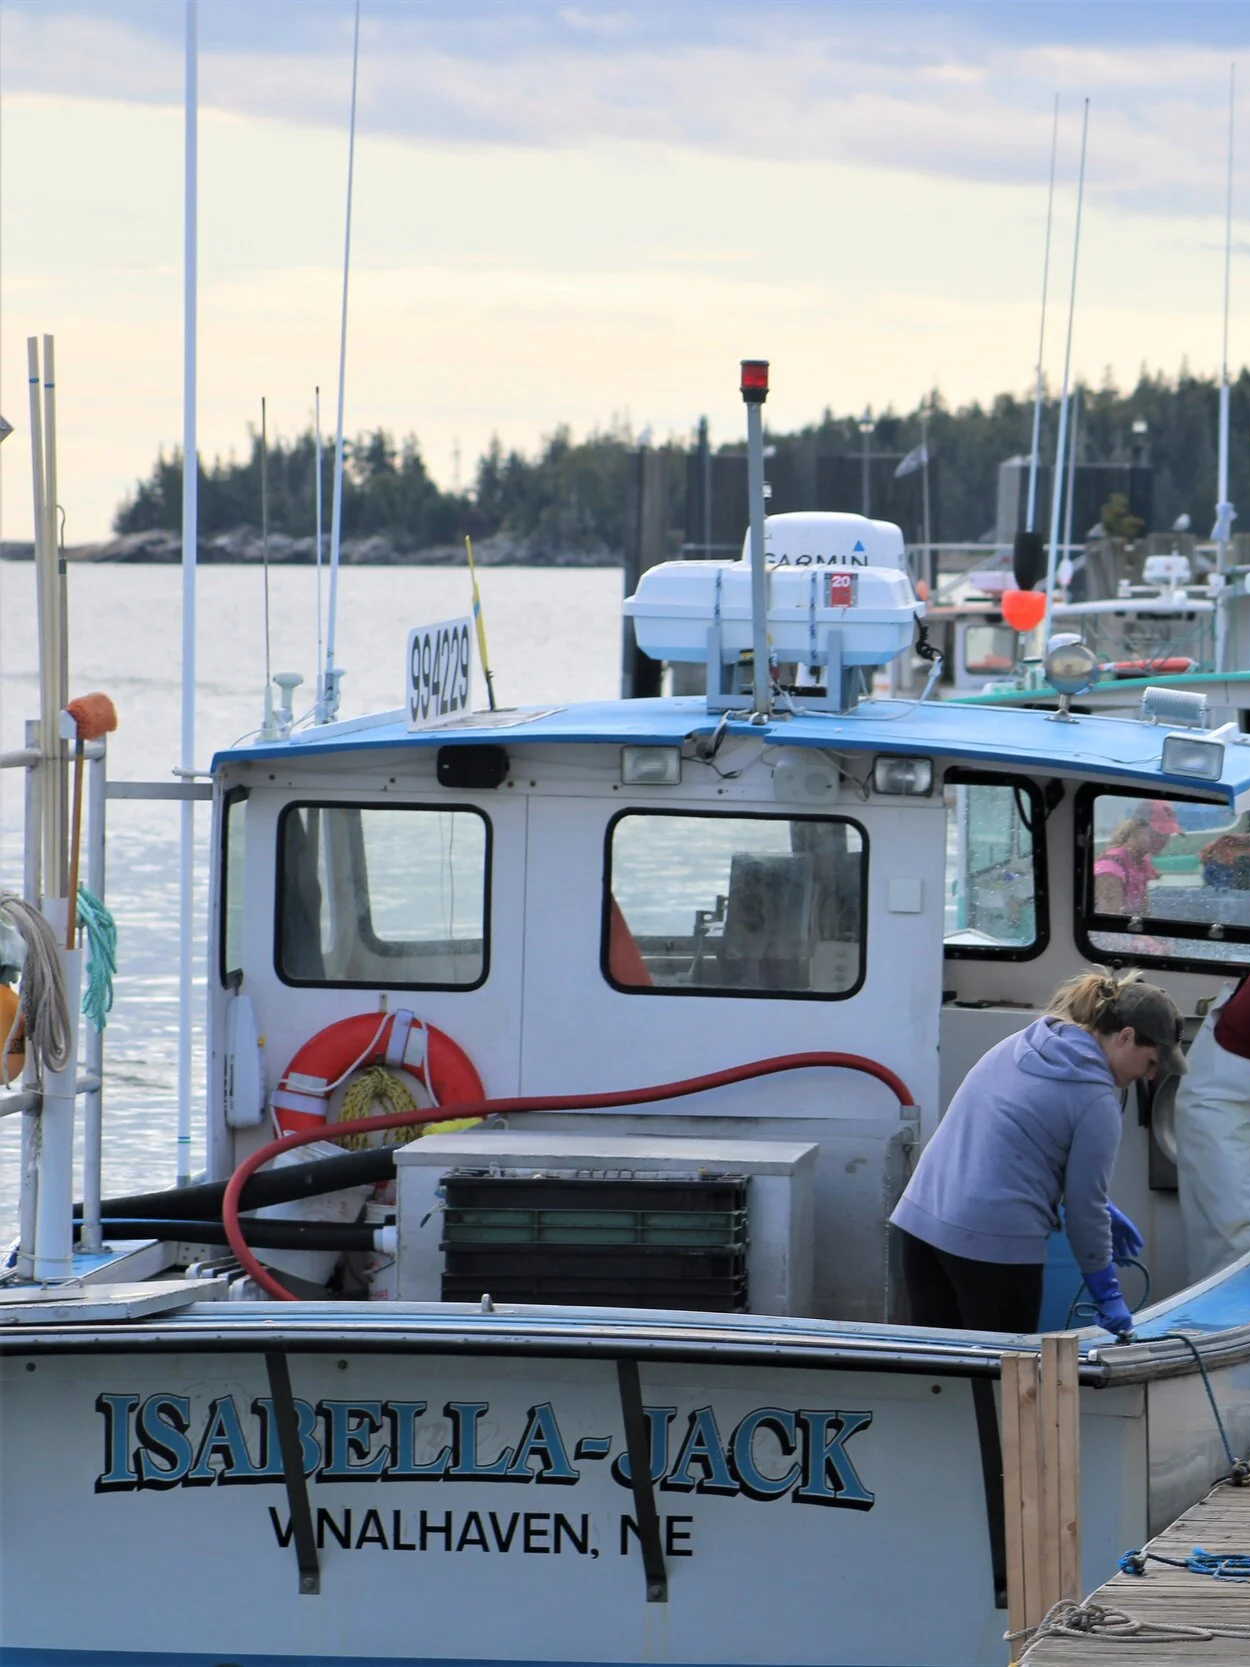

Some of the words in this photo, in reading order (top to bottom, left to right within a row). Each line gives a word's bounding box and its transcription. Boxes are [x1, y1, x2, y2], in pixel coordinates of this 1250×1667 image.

[831, 574, 850, 588] 20
[410, 624, 469, 722] 994229
[95, 1392, 875, 1512] ISABELLA-JACK
[268, 1506, 600, 1560] VNALHAVEN,
